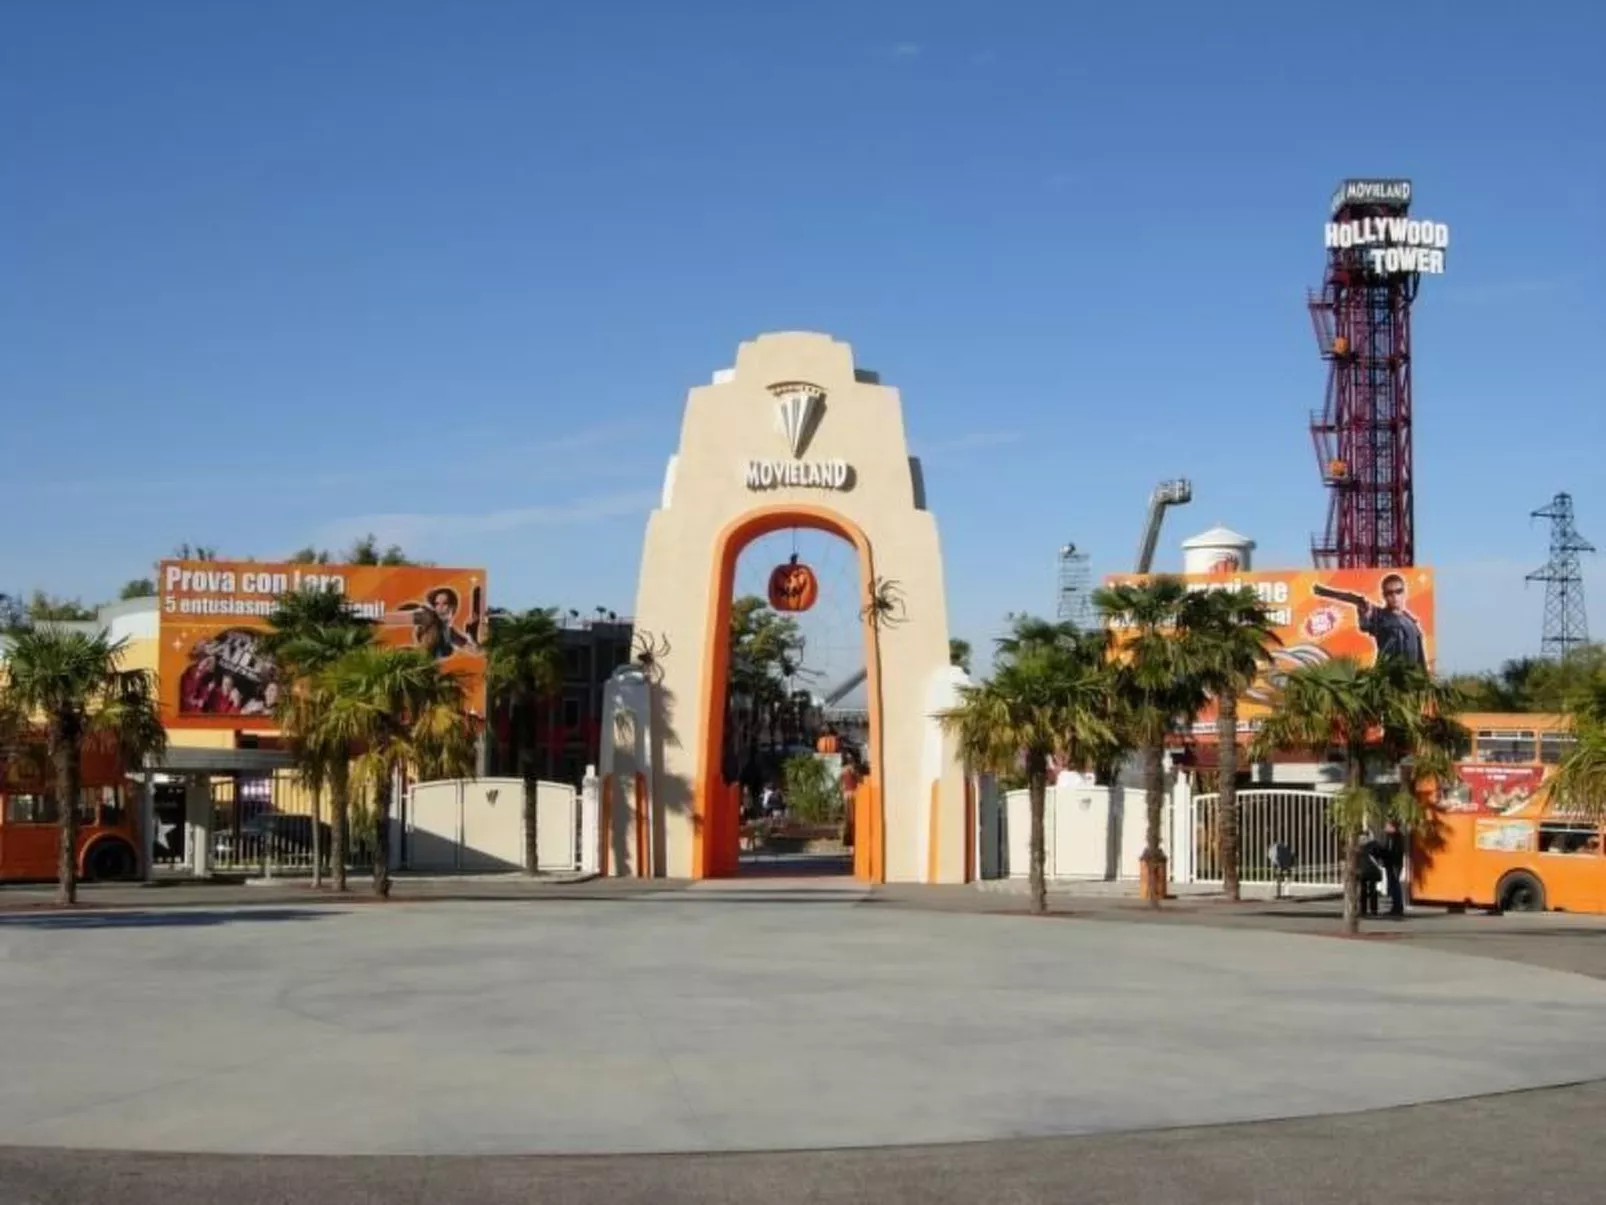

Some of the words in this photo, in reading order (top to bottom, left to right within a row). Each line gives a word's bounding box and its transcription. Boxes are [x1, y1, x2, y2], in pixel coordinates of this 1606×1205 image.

[1346, 182, 1410, 200] MOVIELAND
[1325, 217, 1449, 248] HOLLYWOOD
[1371, 246, 1444, 274] TOWER
[746, 459, 849, 488] MOVIELAND
[166, 565, 236, 592] Prova
[242, 571, 287, 594] con
[165, 595, 176, 613] 5
